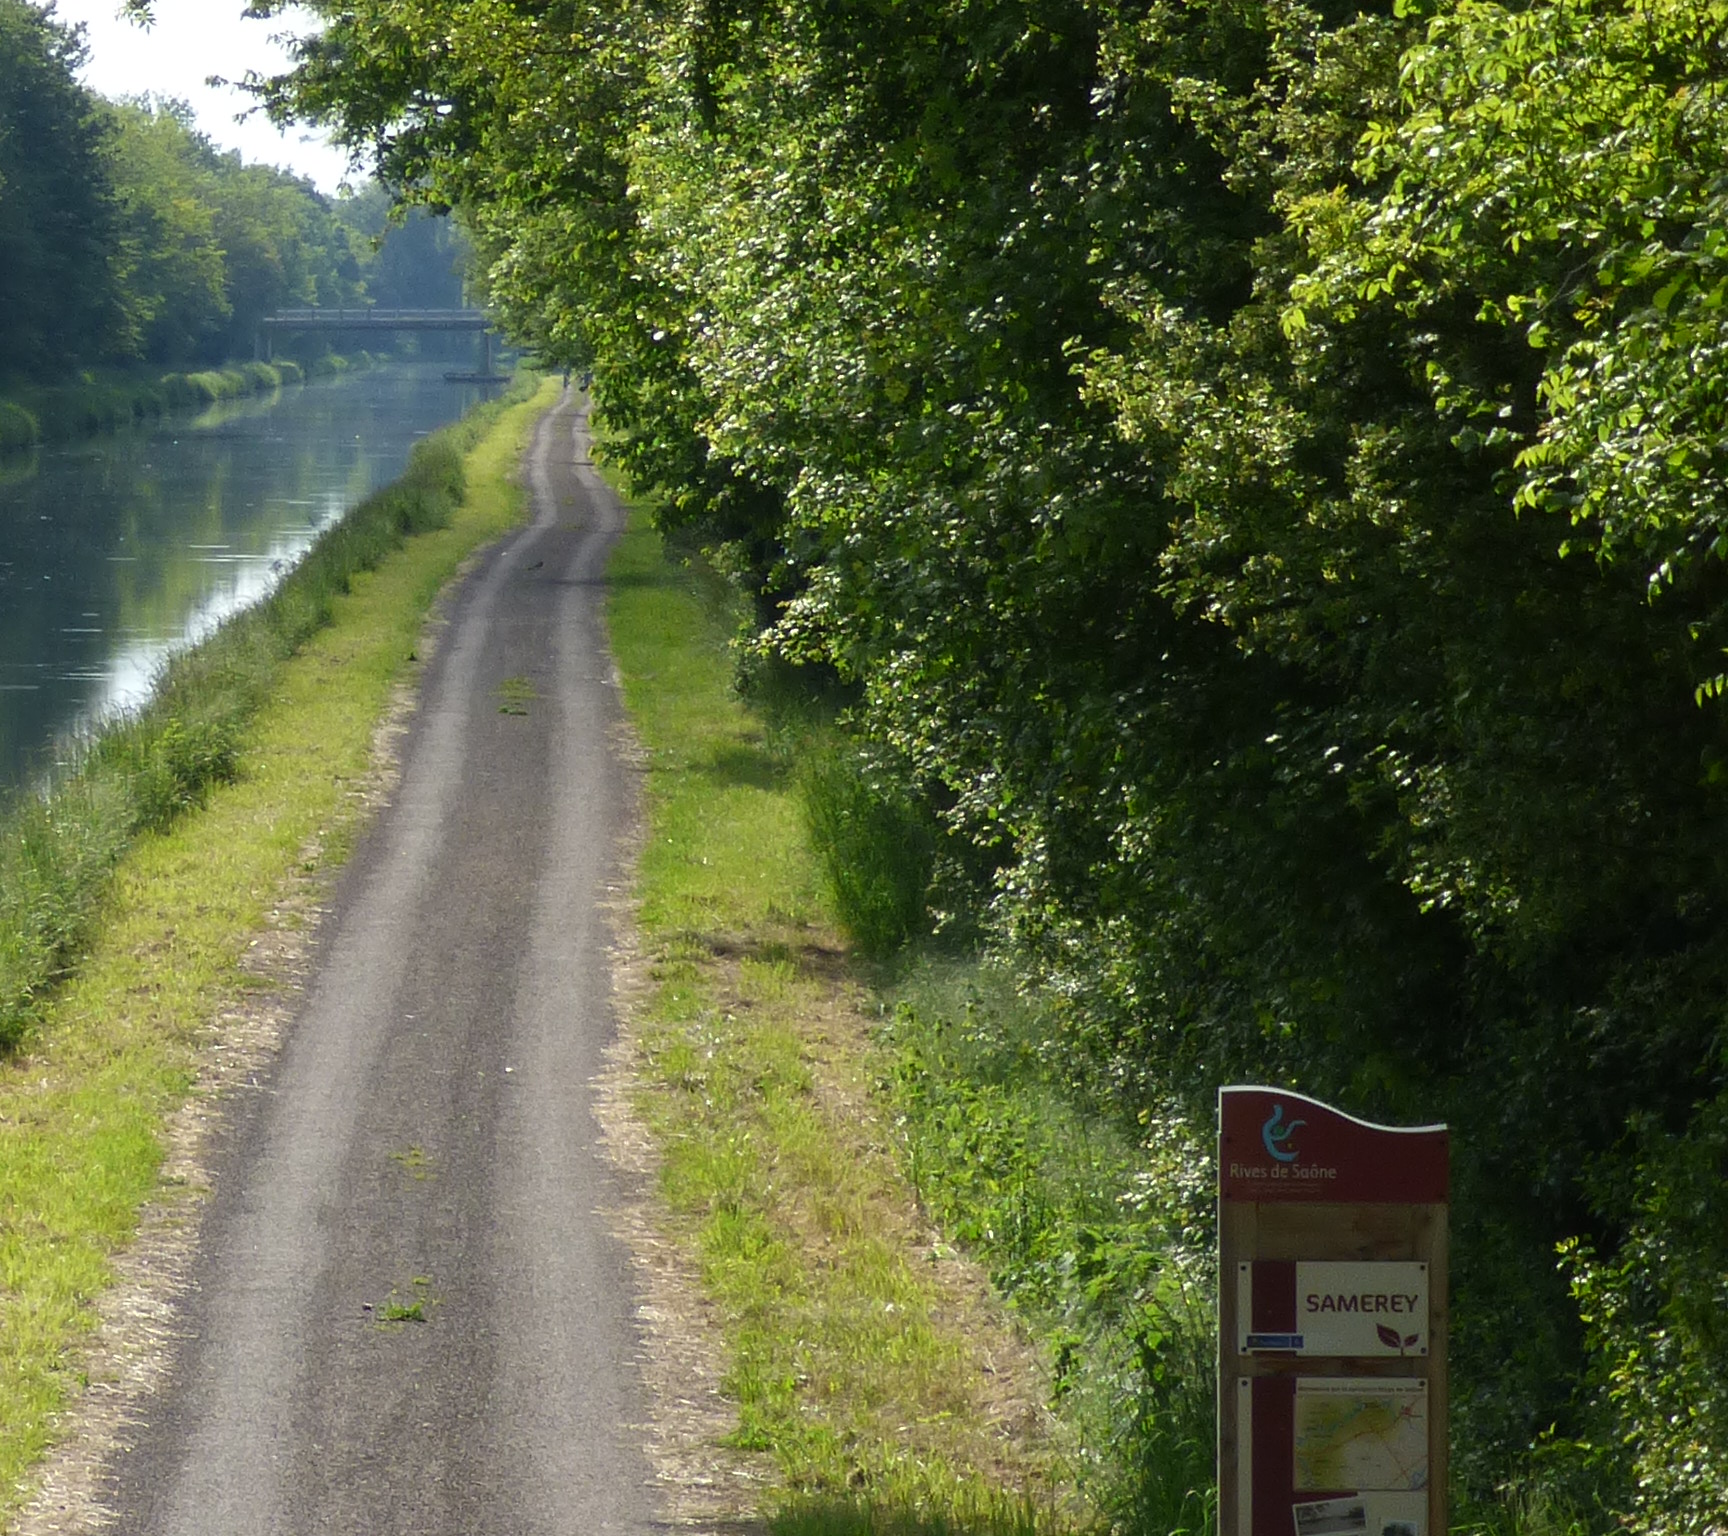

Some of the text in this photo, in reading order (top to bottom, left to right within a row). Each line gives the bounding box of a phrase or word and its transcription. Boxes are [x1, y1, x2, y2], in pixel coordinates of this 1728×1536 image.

[1230, 1162, 1337, 1179] Rives de Saône
[1306, 1294, 1418, 1312] SAMEREY
